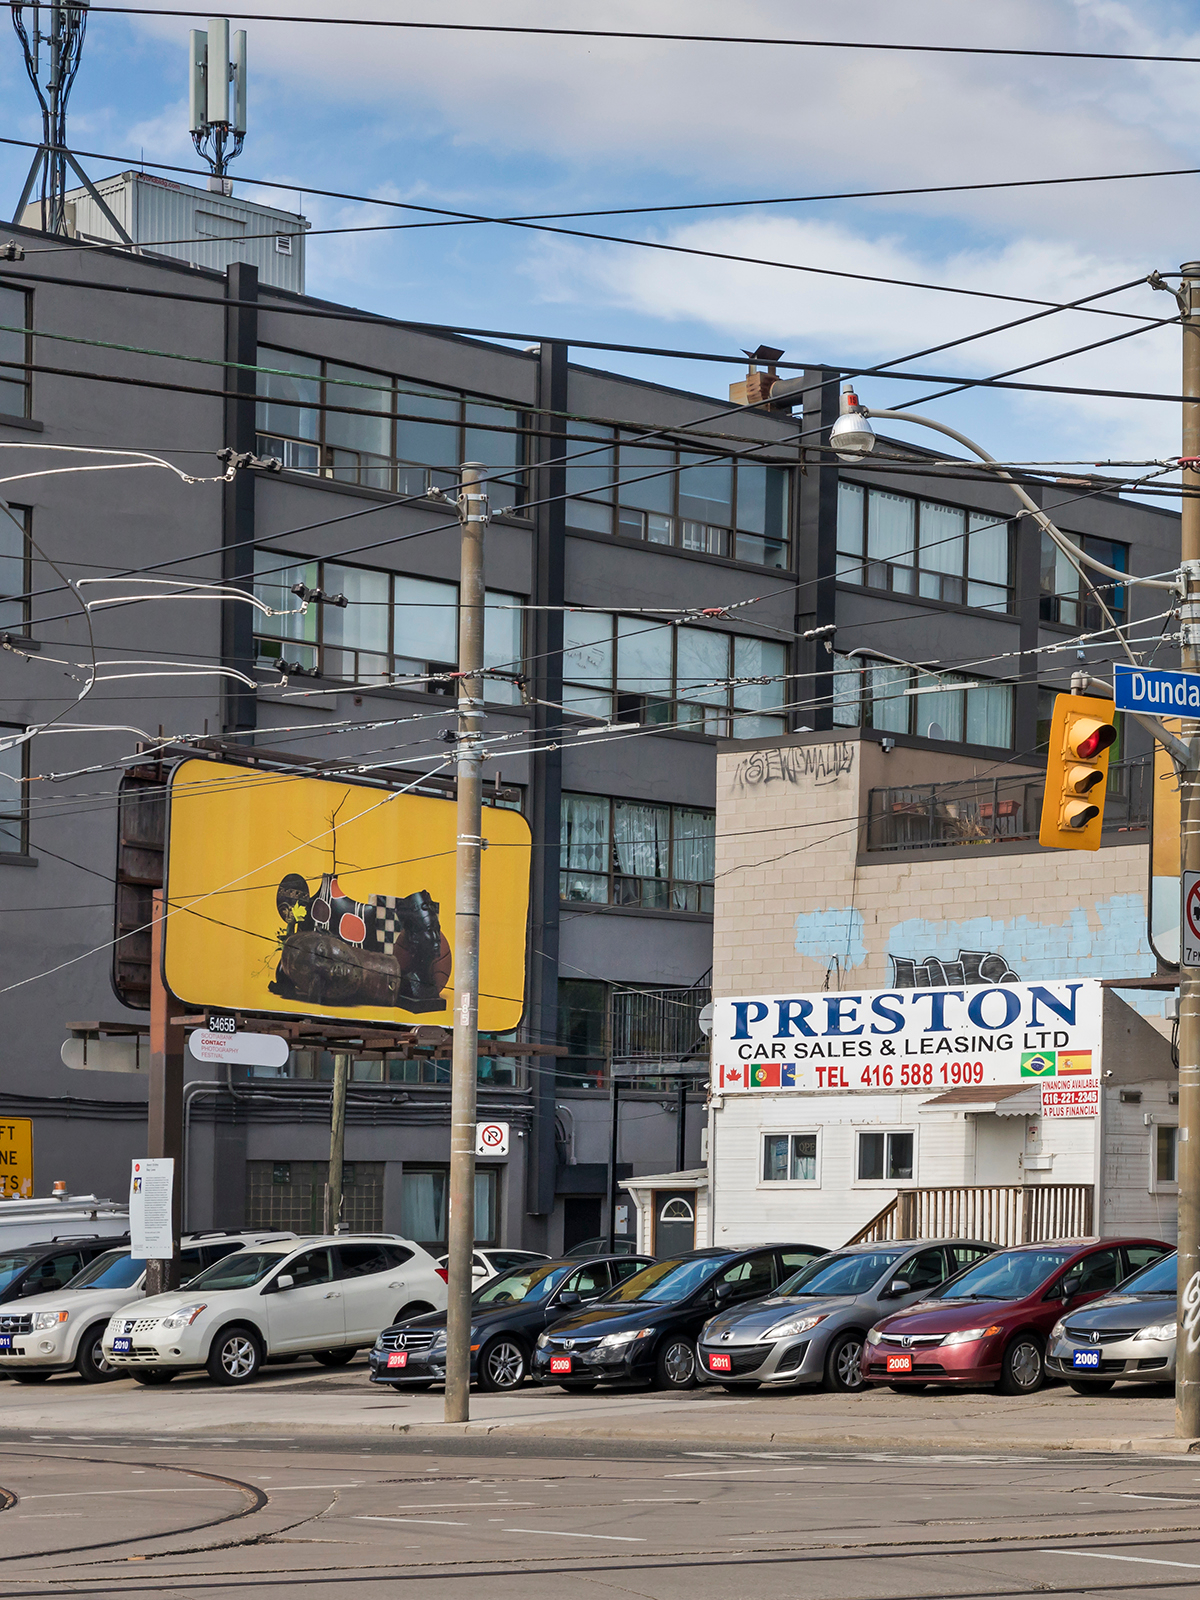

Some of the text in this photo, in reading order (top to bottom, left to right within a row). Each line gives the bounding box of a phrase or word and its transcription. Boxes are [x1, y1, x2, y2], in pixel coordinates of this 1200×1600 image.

[730, 983, 1083, 1040] PRESTON
[209, 1017, 236, 1032] 5465B
[738, 1031, 1070, 1060] CAR SALES & LEASING LTD
[815, 1061, 983, 1087] TEL 416 588 1909
[1042, 1078, 1099, 1090] FINANCING AVAILABLE
[1043, 1091, 1097, 1104] 416-221-2345
[1043, 1105, 1098, 1117] A PLUS FINANCIAL
[114, 1340, 129, 1349] 2010
[389, 1355, 405, 1365] 2014
[553, 1360, 570, 1370] 2009
[712, 1357, 728, 1368] 2011
[889, 1358, 910, 1369] 2008
[1075, 1353, 1098, 1365] 2006
